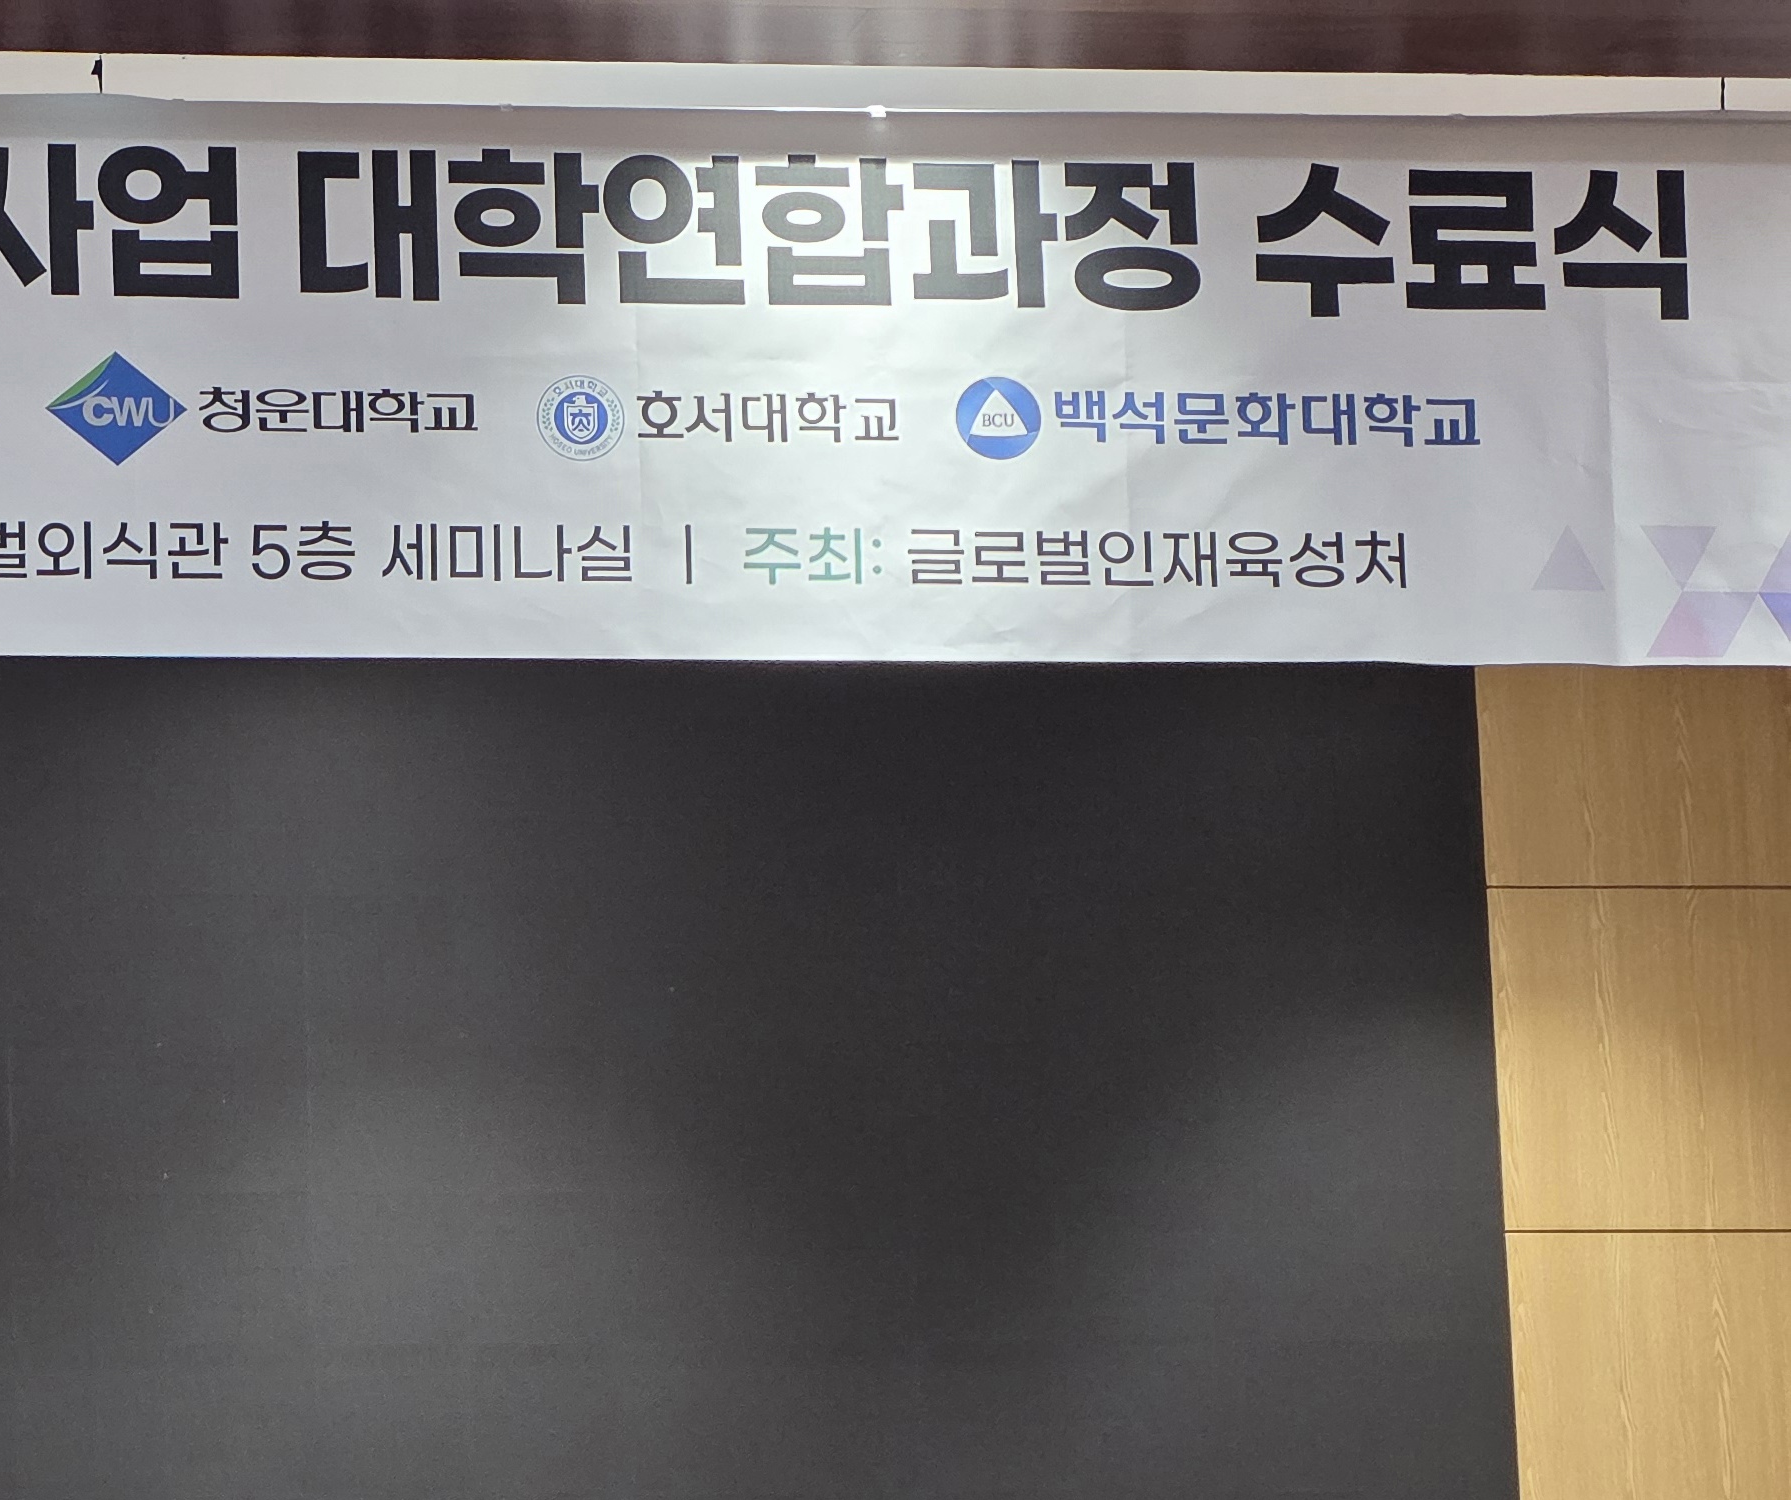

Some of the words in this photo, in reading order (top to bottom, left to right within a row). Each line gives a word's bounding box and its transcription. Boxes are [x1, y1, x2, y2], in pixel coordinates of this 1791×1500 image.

[297, 147, 1201, 312] 대학연합과정
[1256, 163, 1689, 321] 수료식
[82, 395, 175, 428] CWU
[199, 386, 478, 433] 청운대학교
[637, 390, 899, 443] 호서대학교
[982, 413, 1015, 428] BCU
[1055, 391, 1480, 447] 백석문화대학교
[252, 521, 355, 580] 5층
[382, 523, 632, 582] 세미나실
[744, 527, 882, 585] 주최:
[908, 529, 1406, 588] 글로벌인재육성처
